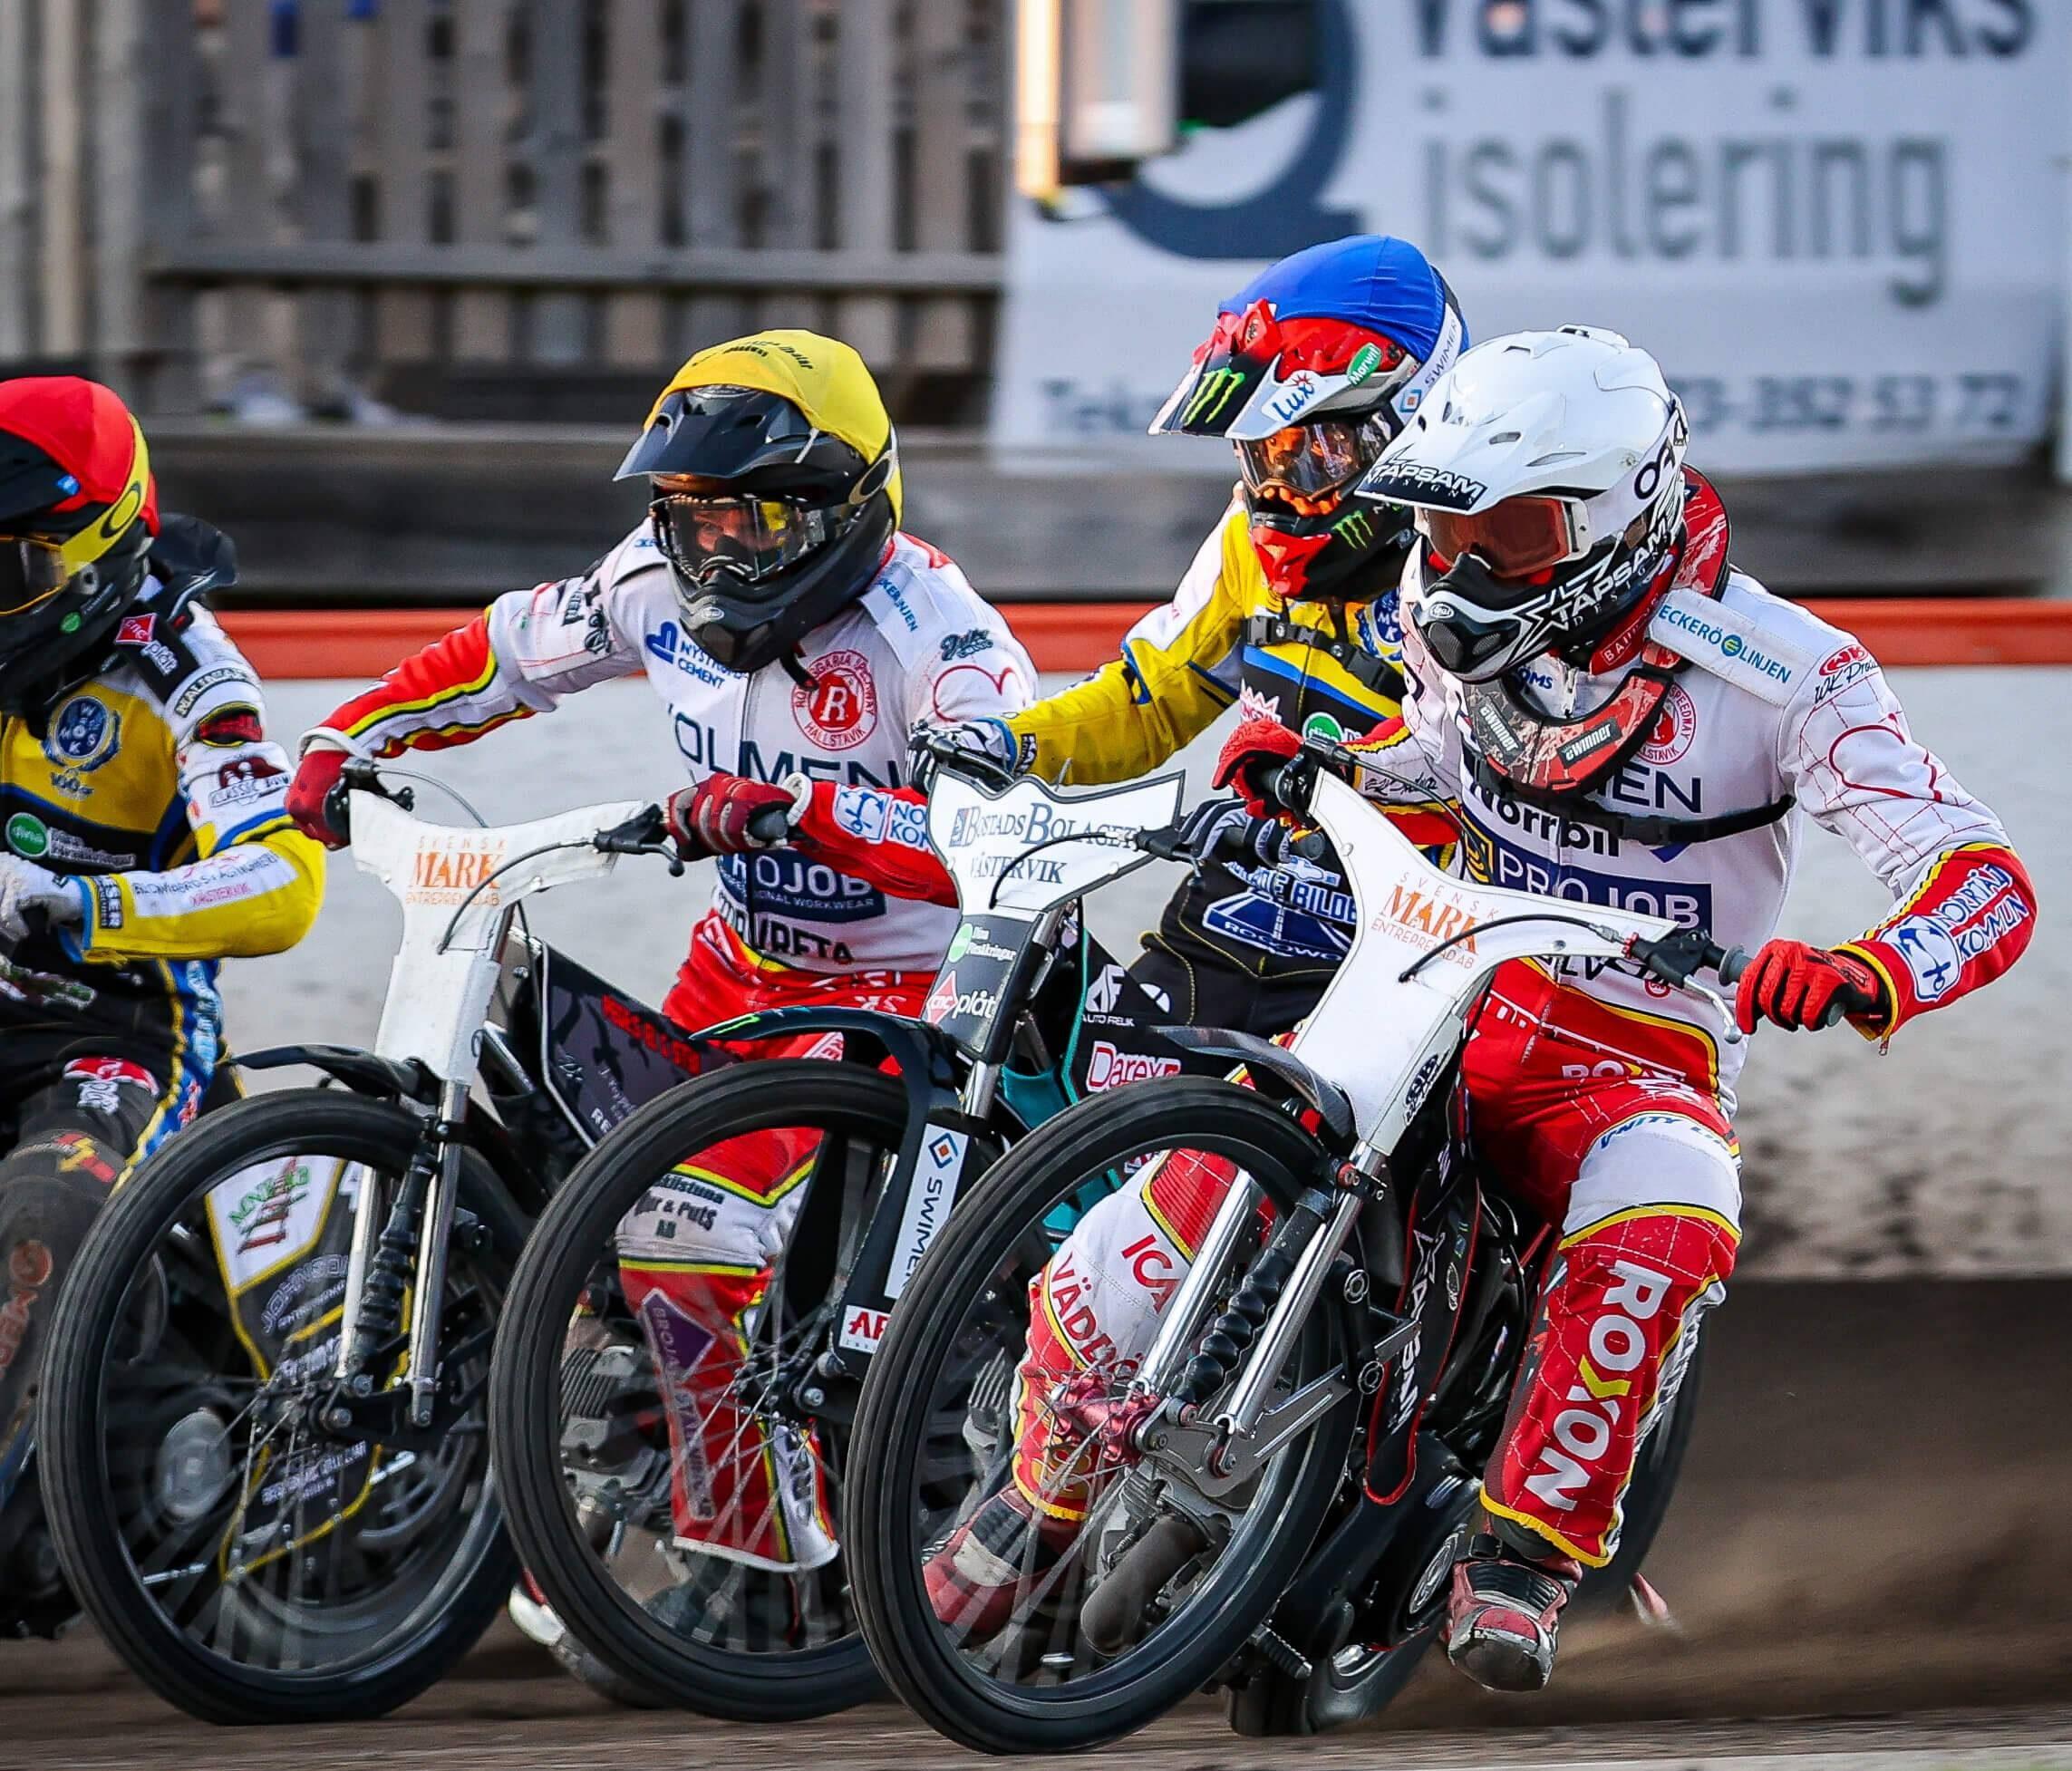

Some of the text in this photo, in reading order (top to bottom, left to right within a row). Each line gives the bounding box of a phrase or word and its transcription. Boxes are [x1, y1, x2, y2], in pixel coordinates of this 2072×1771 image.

[1423, 82, 1951, 306] isolering
[1349, 348, 1380, 385] Marwil
[1272, 383, 1314, 421] Lux
[1659, 605, 1723, 645] ECKERÖ
[1739, 645, 1792, 683] LINJEN
[678, 658, 725, 689] CEMENT
[804, 721, 866, 747] HALLSTAVIK
[1479, 703, 1519, 753] ewinner
[1670, 685, 1689, 740] SPEEDWAY
[668, 703, 903, 790] OLMEN
[1565, 722, 1612, 762] ewinner
[418, 836, 507, 850] SVENSK
[409, 851, 505, 890] MARK
[1498, 847, 1700, 930] PROJOB
[792, 895, 875, 910] WORKWEAR
[1379, 884, 1479, 956] MARK
[1399, 871, 1501, 922] SVENSK
[1956, 893, 2029, 959] KOMMUN
[1457, 956, 1476, 970] AB
[1524, 1260, 1674, 1513] ROXON
